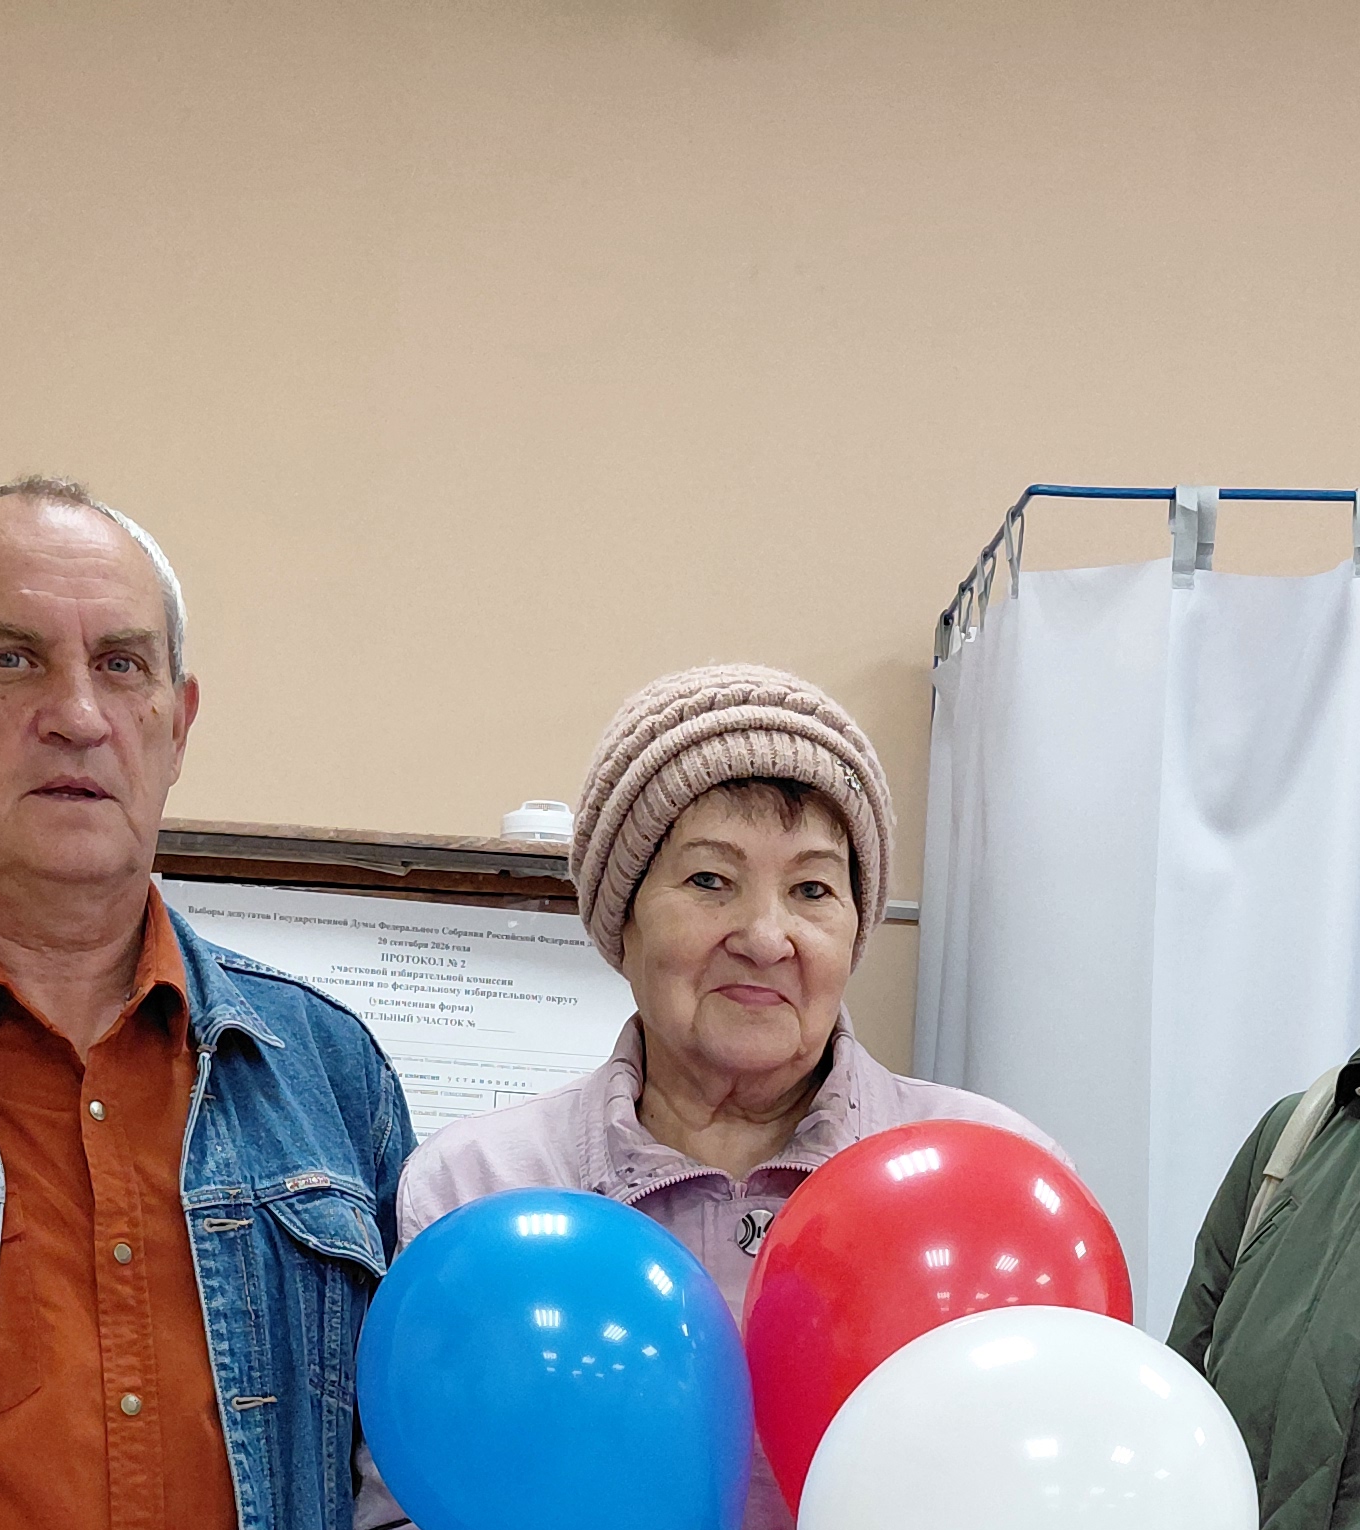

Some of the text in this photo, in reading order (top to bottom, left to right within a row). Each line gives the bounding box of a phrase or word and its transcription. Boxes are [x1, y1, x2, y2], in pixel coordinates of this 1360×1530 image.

[188, 905, 225, 917] Выборы
[227, 910, 271, 921] депутатов
[273, 912, 349, 927] Государственной
[350, 918, 376, 930] Думы
[378, 921, 440, 935] Федерального
[442, 926, 484, 939] Собрания
[486, 930, 536, 943] Российской
[537, 935, 585, 947] Федерации
[377, 937, 471, 953] 20 сентября 2026 года
[381, 952, 466, 969] ПРОТОКОЛ № 2
[331, 965, 514, 986] участковой избирательной комиссии
[312, 976, 375, 988] голосования
[377, 981, 388, 989] по
[391, 981, 461, 996] федеральному
[464, 987, 543, 1003] избирательному
[546, 994, 578, 1006] округу
[369, 996, 474, 1014] (увеличенная форма)
[359, 1011, 476, 1028] ТЕЛЬНЫЙ УЧАСТОК №
